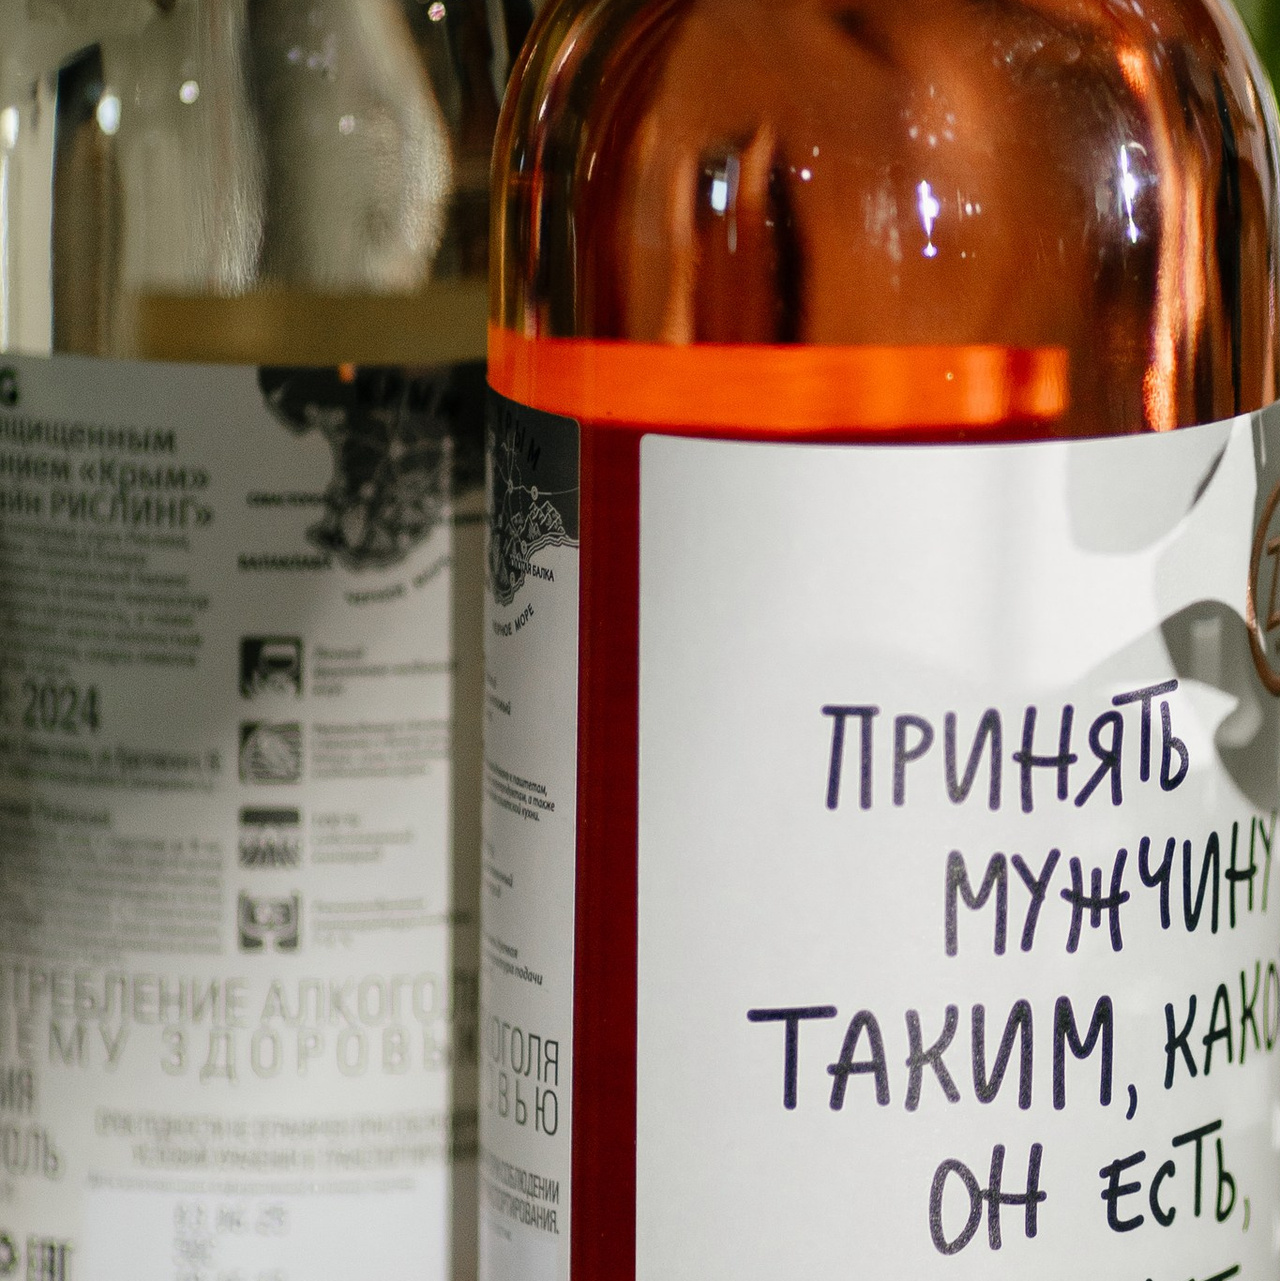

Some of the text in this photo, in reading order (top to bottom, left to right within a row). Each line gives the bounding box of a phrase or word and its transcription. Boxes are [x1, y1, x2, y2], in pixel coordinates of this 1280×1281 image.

[514, 603, 534, 631] МОРЕ
[532, 564, 555, 582] БАЛКА
[22, 680, 101, 734] 2024
[821, 678, 1190, 814] ПРИНЯТЬ
[945, 809, 1278, 957] МУЖЧИНУ
[514, 967, 543, 986] подачи
[746, 995, 1139, 1121] ТАКИМ,
[929, 1120, 1251, 1259] ОН ЕСТЬ,
